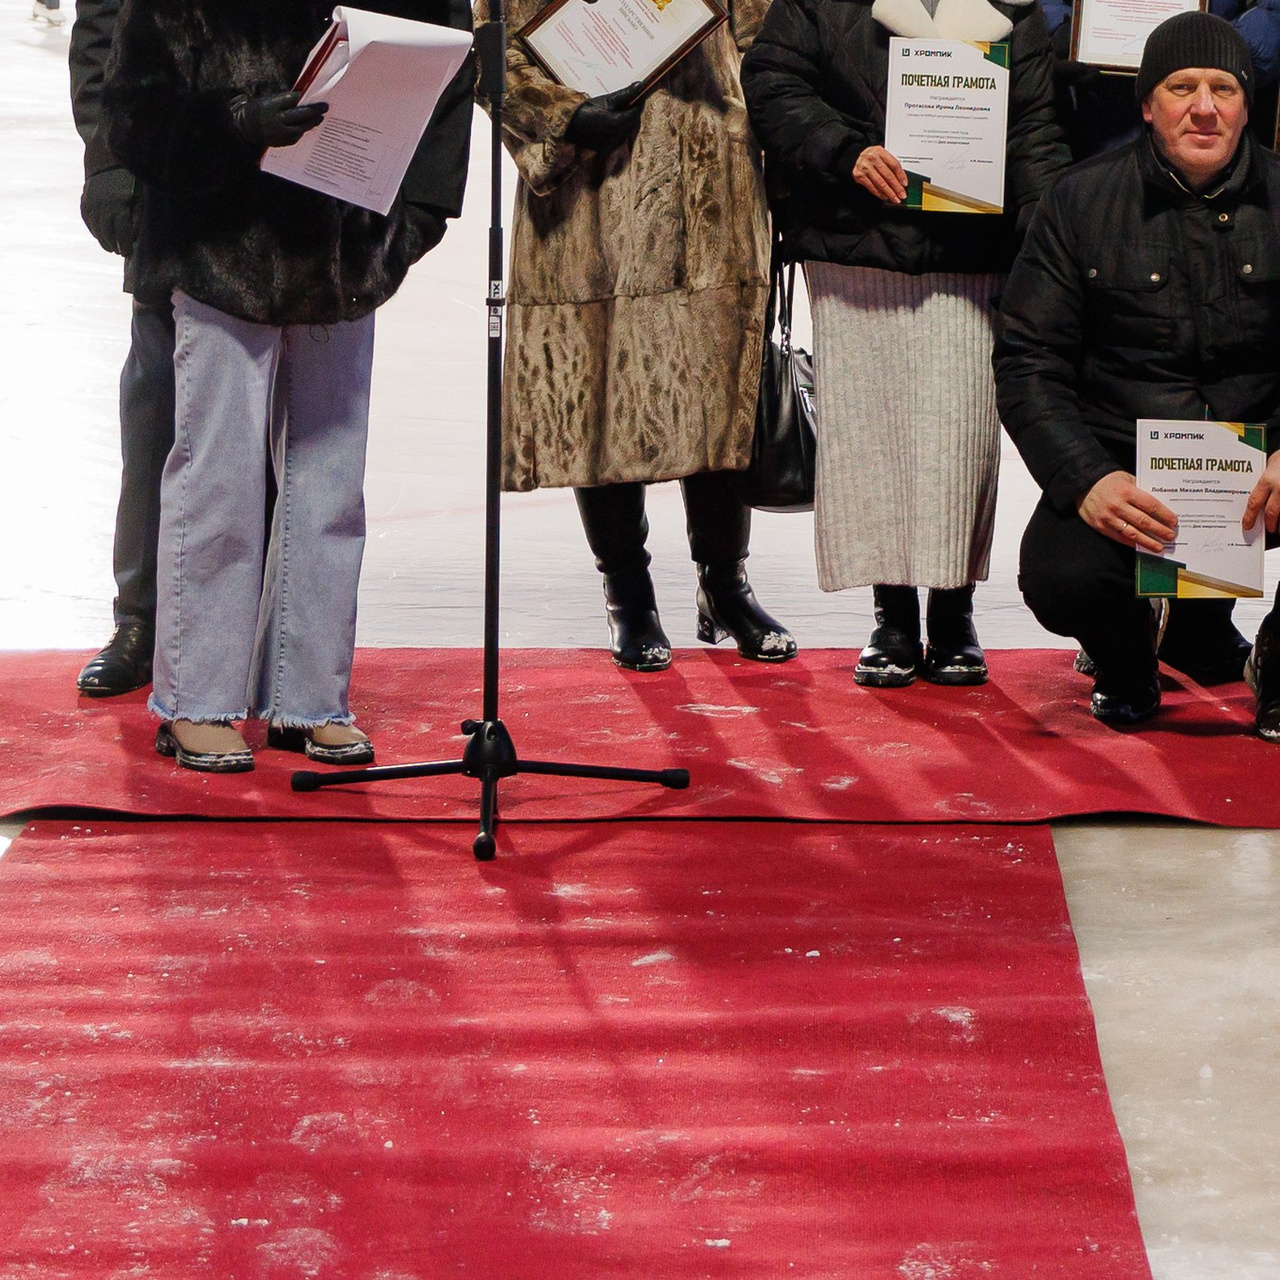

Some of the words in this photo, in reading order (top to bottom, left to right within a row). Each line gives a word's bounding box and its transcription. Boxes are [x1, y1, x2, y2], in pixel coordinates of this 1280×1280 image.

[914, 50, 952, 58] ХРОМПИК
[901, 74, 950, 87] ПОЧЕТНАЯ
[952, 76, 996, 90] ГРАМОТА
[1150, 457, 1202, 470] ПОЧЕТНАЯ
[1206, 459, 1253, 473] ГРАМОТА
